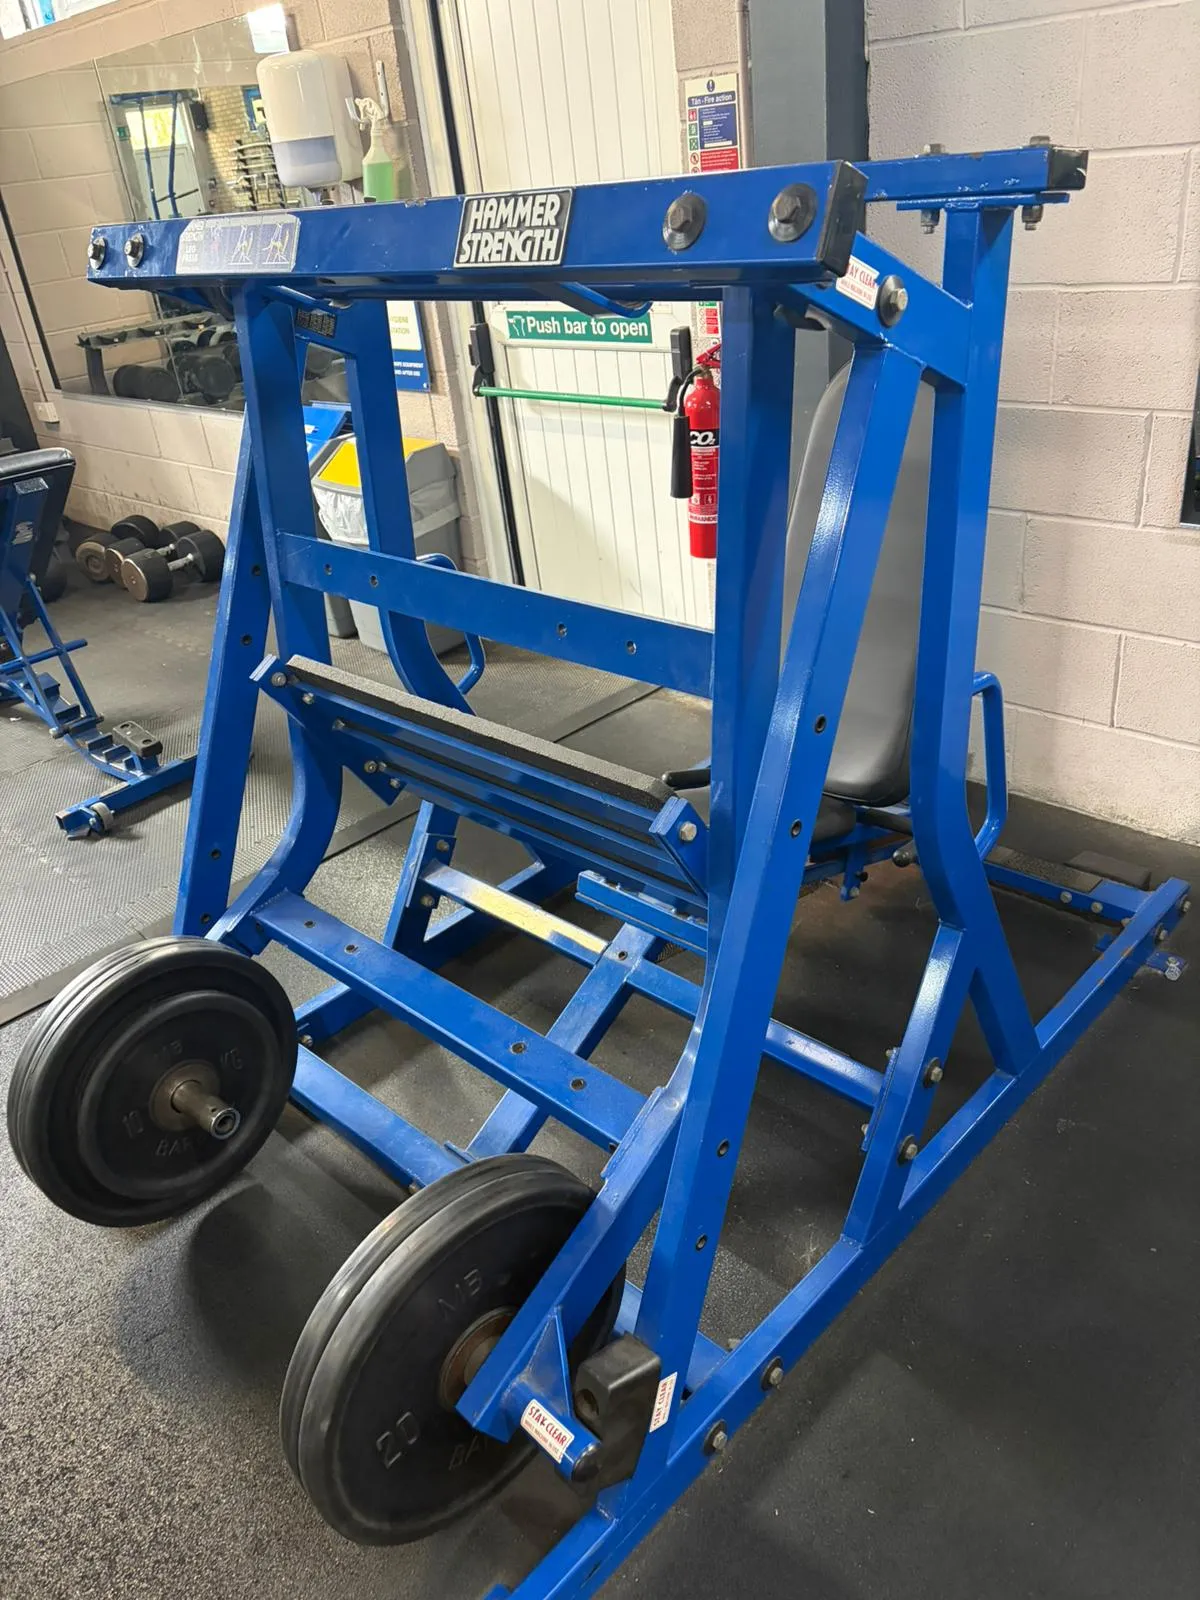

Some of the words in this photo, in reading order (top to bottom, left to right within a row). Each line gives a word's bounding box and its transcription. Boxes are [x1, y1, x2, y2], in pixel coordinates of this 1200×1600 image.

[704, 95, 715, 104] Fire
[716, 94, 733, 103] action
[469, 193, 561, 230] HAMMER
[458, 228, 560, 263] STRENGTH
[526, 316, 561, 335] Push
[563, 318, 588, 335] bar
[591, 320, 606, 335] to
[609, 321, 649, 339] open
[376, 1410, 420, 1470] 20
[528, 1405, 548, 1427] STAY
[545, 1422, 568, 1446] CLEAR
